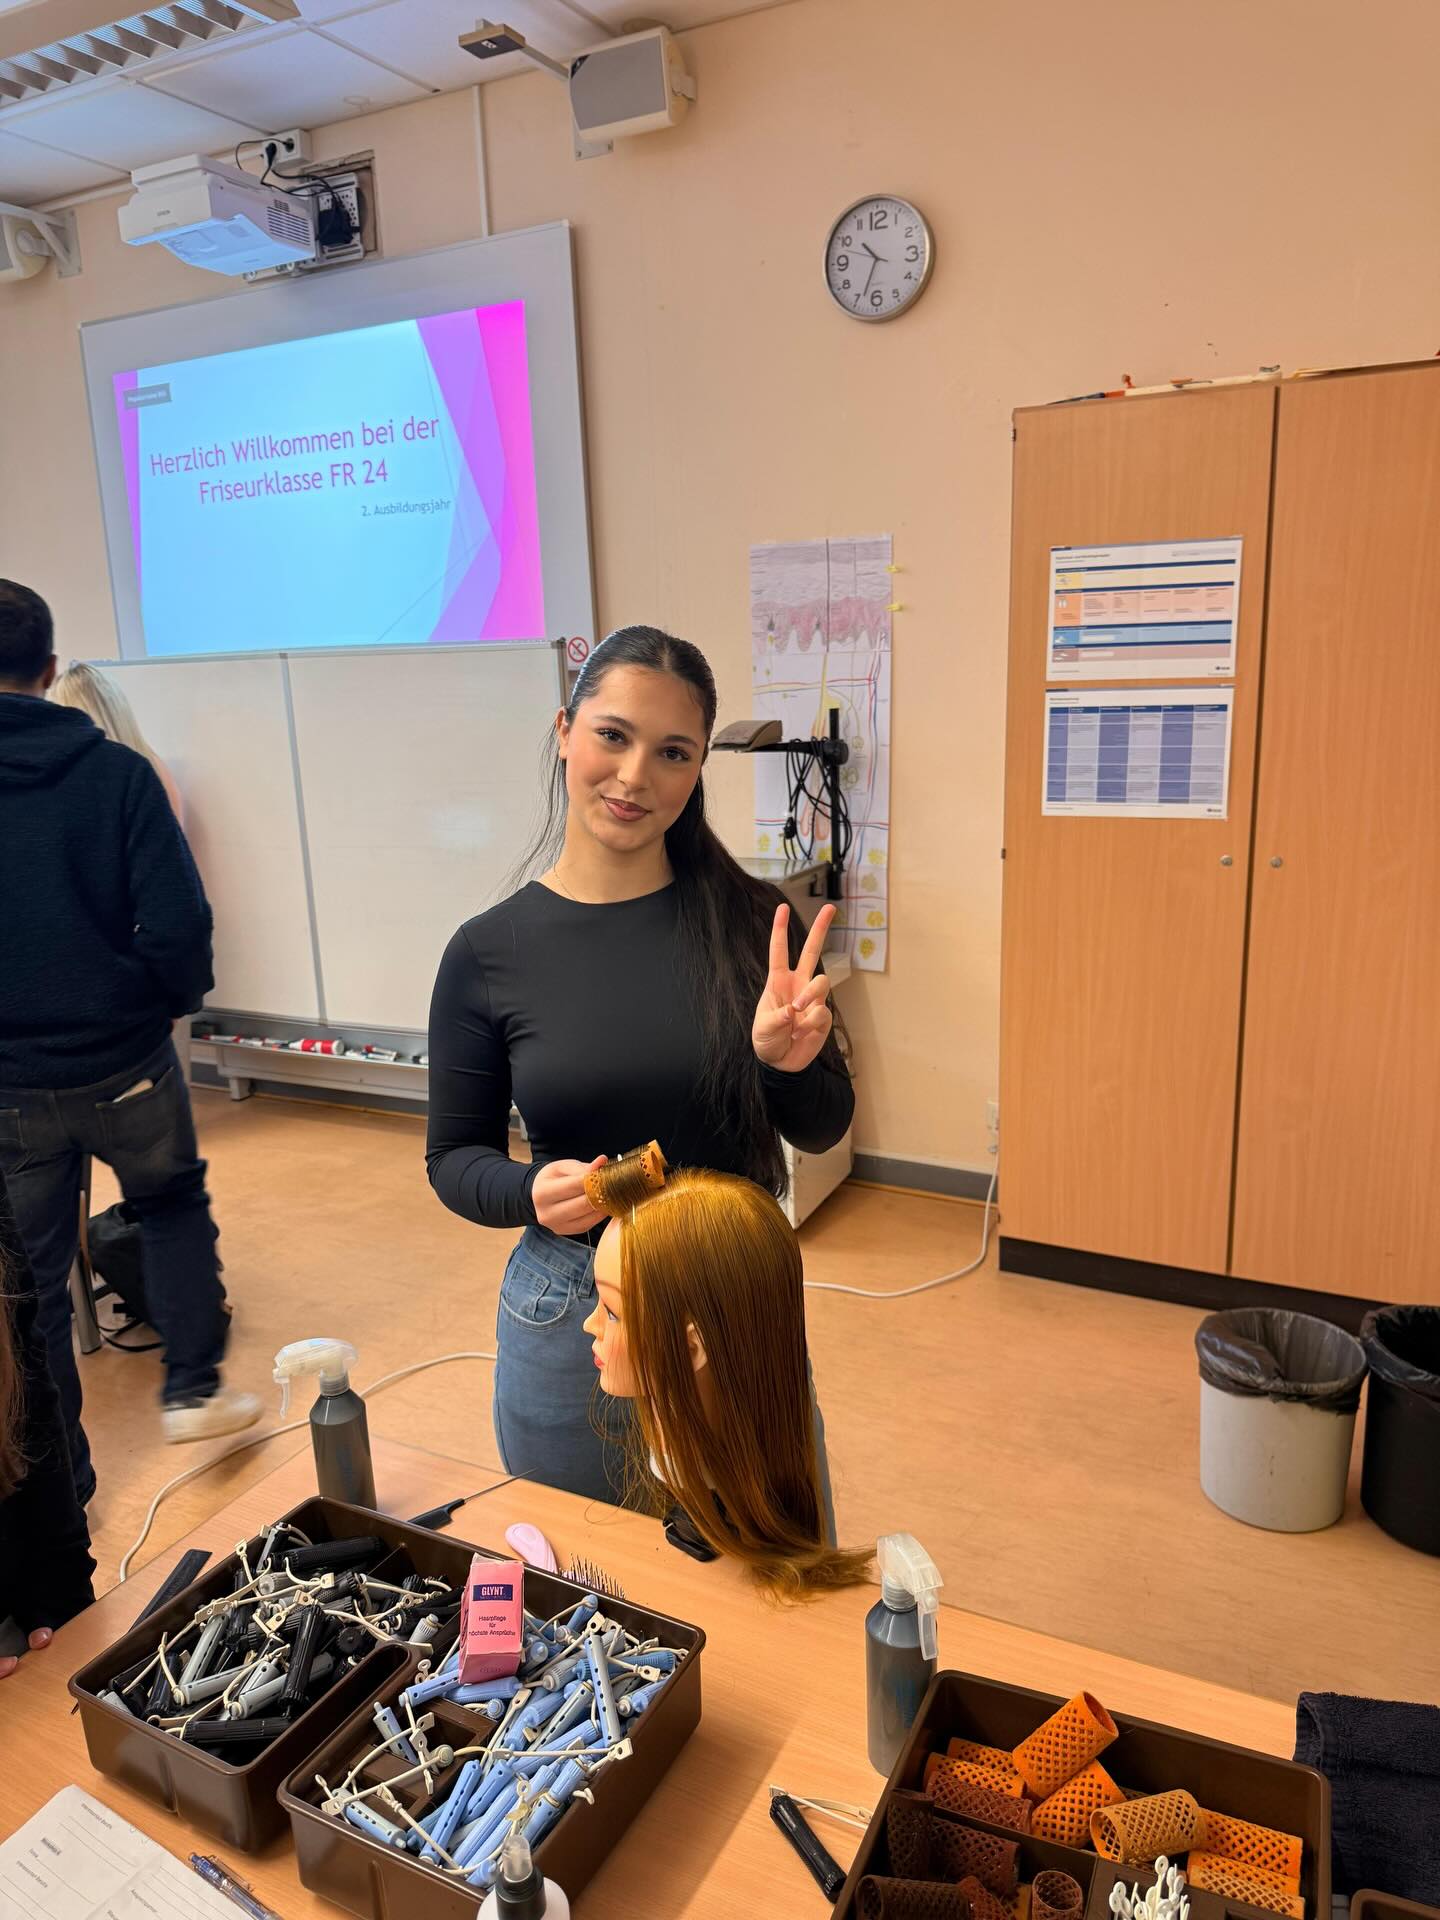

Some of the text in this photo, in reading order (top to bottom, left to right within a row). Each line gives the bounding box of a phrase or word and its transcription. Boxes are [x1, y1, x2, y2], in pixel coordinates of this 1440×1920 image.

[856, 218, 864, 231] 11
[869, 209, 889, 231] 12
[904, 226, 914, 239] 2
[841, 235, 853, 248] 10
[905, 245, 919, 262] 3
[836, 254, 850, 272] 9
[903, 271, 913, 281] 4
[842, 279, 851, 290] 8
[853, 293, 862, 304] 7
[870, 290, 883, 307] 6
[892, 288, 900, 299] 5
[150, 415, 440, 476] Herzlich Willkommen bei der
[199, 458, 388, 504] Friseurklasse FR 24
[361, 498, 451, 517] 2. Ausbildungsjahr
[481, 1586, 504, 1596] GLYNT
